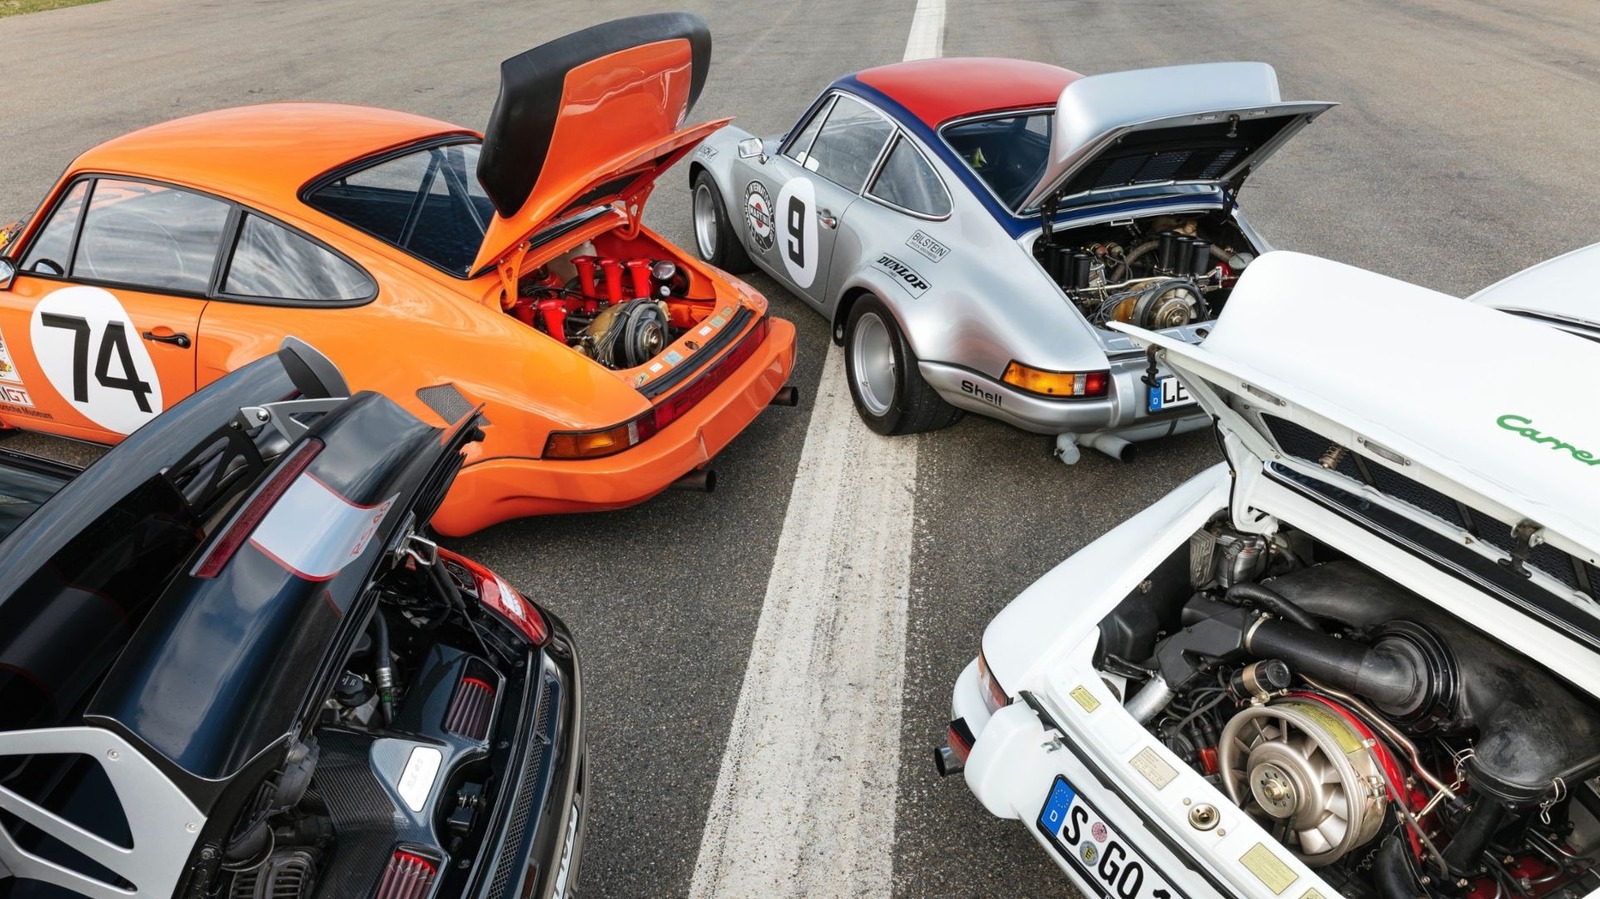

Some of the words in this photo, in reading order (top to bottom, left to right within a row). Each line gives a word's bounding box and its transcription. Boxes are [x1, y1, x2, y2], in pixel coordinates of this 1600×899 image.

[787, 195, 806, 269] 9
[912, 232, 947, 257] BILSTEIN
[876, 256, 928, 290] DUNLOP
[40, 311, 153, 414] 74
[6, 388, 28, 404] GT
[961, 380, 1002, 407] Shell
[1153, 397, 1159, 405] D
[1163, 380, 1189, 404] LE
[1496, 414, 1600, 466] Carre
[1049, 809, 1059, 823] D
[1062, 804, 1089, 846] S
[1097, 840, 1144, 899] GO
